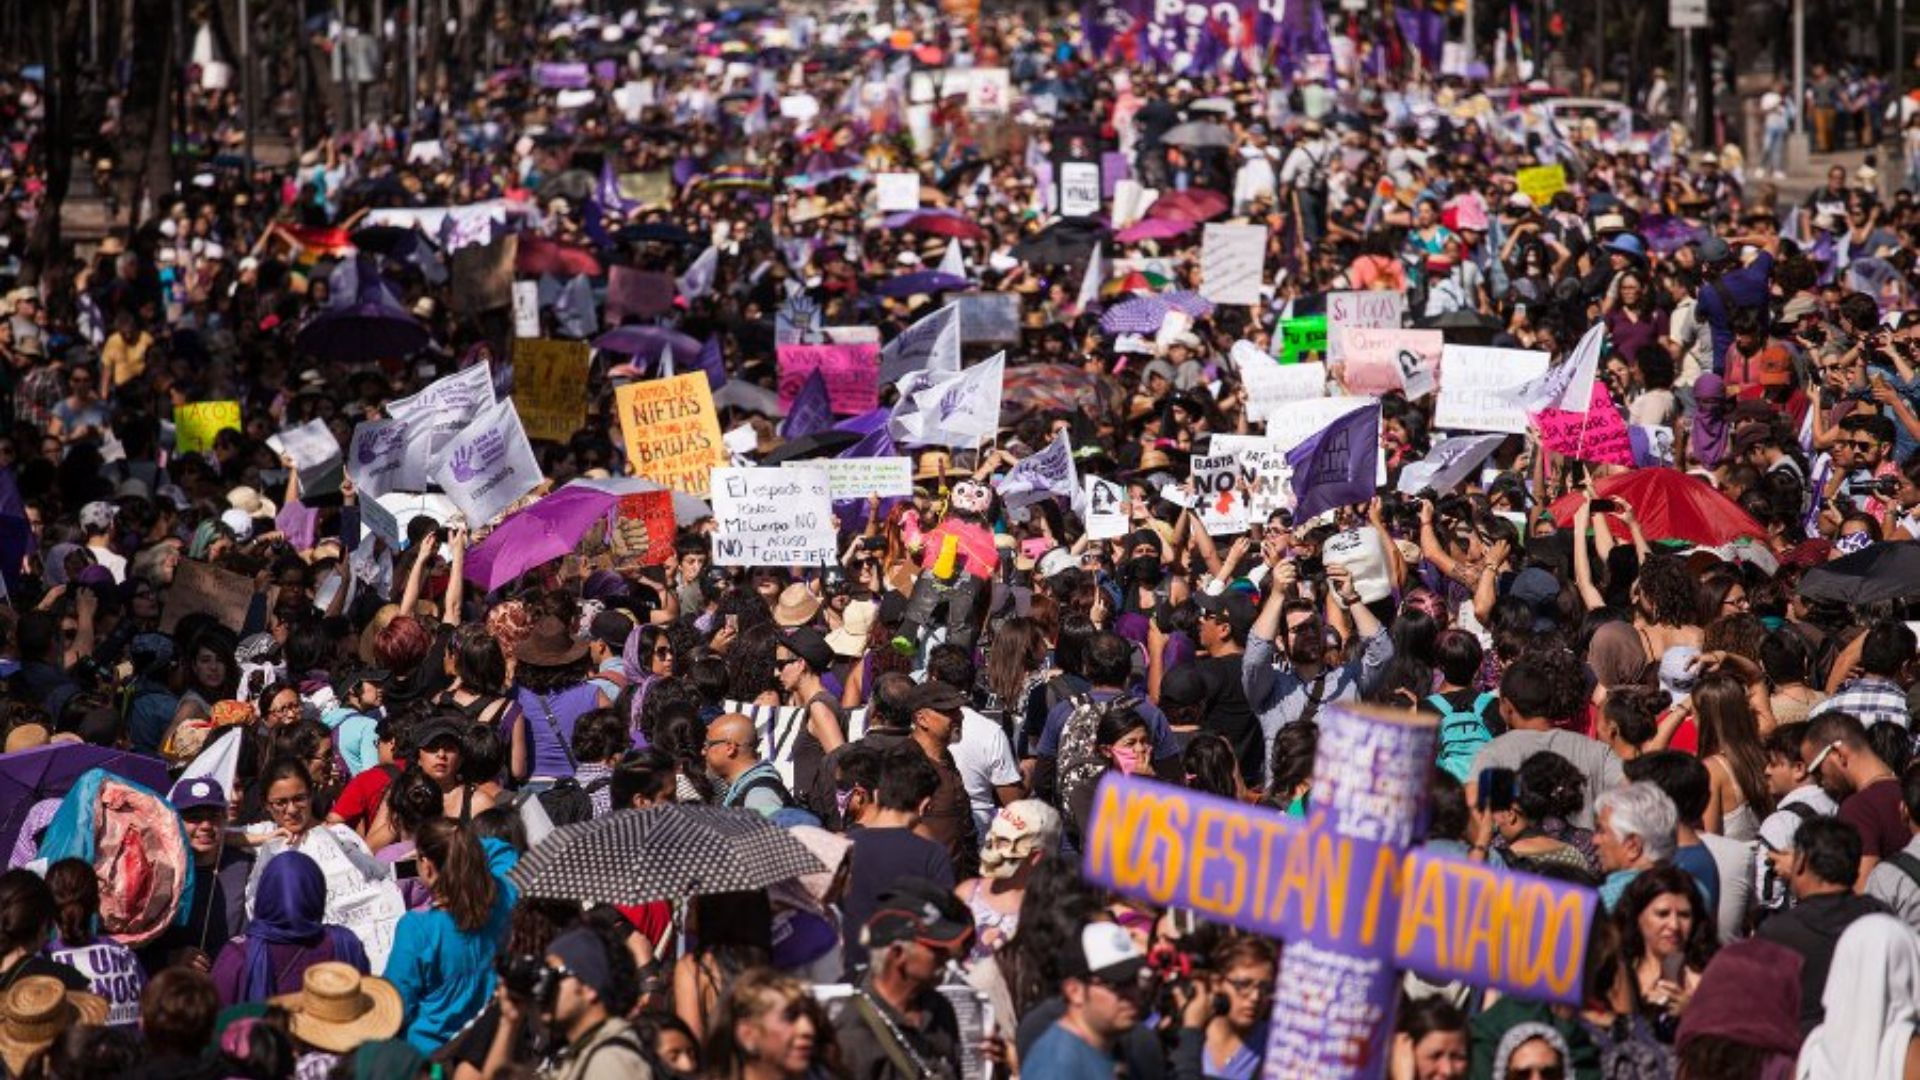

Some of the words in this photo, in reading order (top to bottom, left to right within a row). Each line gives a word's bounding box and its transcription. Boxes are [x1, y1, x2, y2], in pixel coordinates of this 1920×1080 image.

[632, 395, 702, 426] NIETAS
[636, 430, 711, 463] BRUJAS
[1194, 455, 1235, 470] BASTA
[1262, 459, 1288, 470] BAS
[725, 475, 748, 498] El
[1194, 471, 1236, 495] NO
[795, 511, 817, 530] NO
[718, 538, 743, 559] NO
[1089, 784, 1189, 902] NOS
[1188, 807, 1352, 940] ESTÁN
[1361, 844, 1584, 997] MATANDO
[95, 975, 140, 1004] NOS
